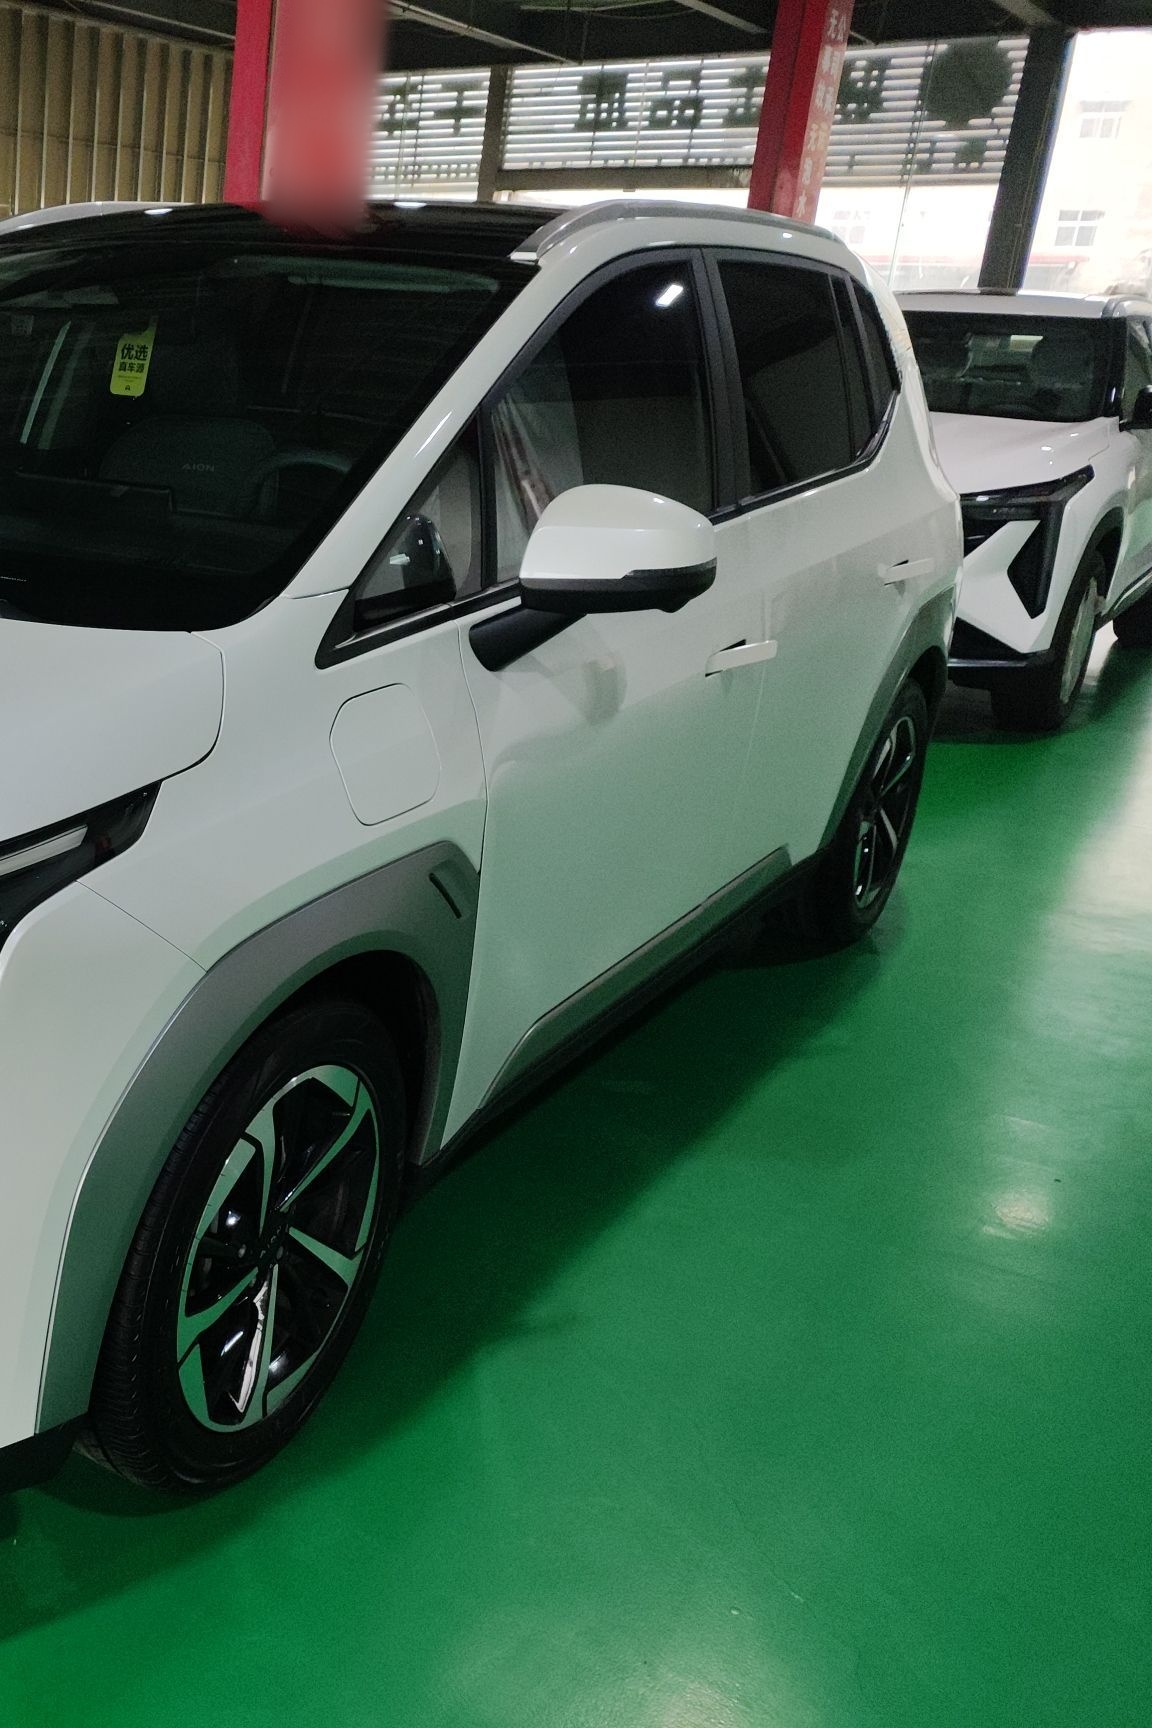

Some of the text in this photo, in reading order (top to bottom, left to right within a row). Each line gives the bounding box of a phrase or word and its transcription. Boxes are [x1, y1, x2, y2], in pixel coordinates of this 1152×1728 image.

[120, 343, 149, 361] 优选
[118, 361, 145, 374] 真车源
[181, 463, 215, 473] AION
